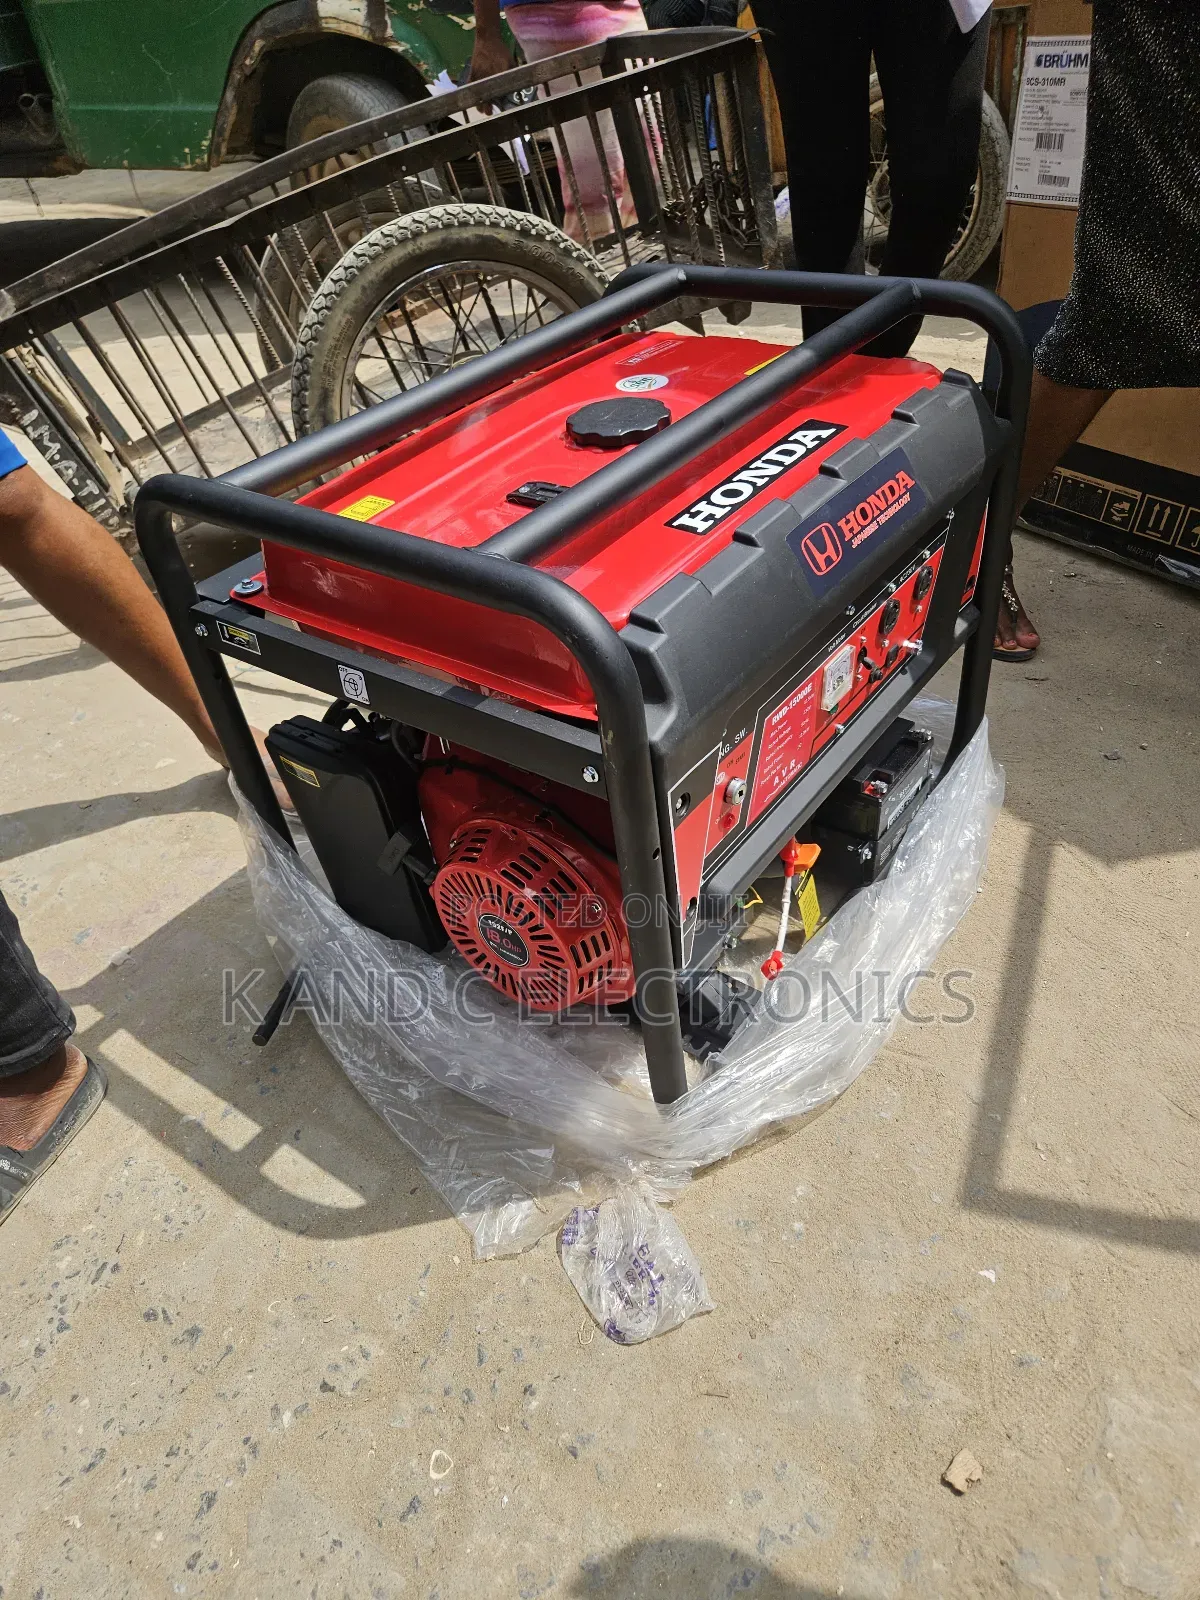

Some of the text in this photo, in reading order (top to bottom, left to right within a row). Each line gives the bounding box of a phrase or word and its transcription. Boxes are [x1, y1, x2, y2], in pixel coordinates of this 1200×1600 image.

[1043, 49, 1089, 69] BRÜHM
[671, 427, 837, 533] HONDA
[837, 470, 915, 541] HONDA
[851, 492, 911, 549] JAPANESE TECHNOLOGY
[734, 727, 748, 744] SW.
